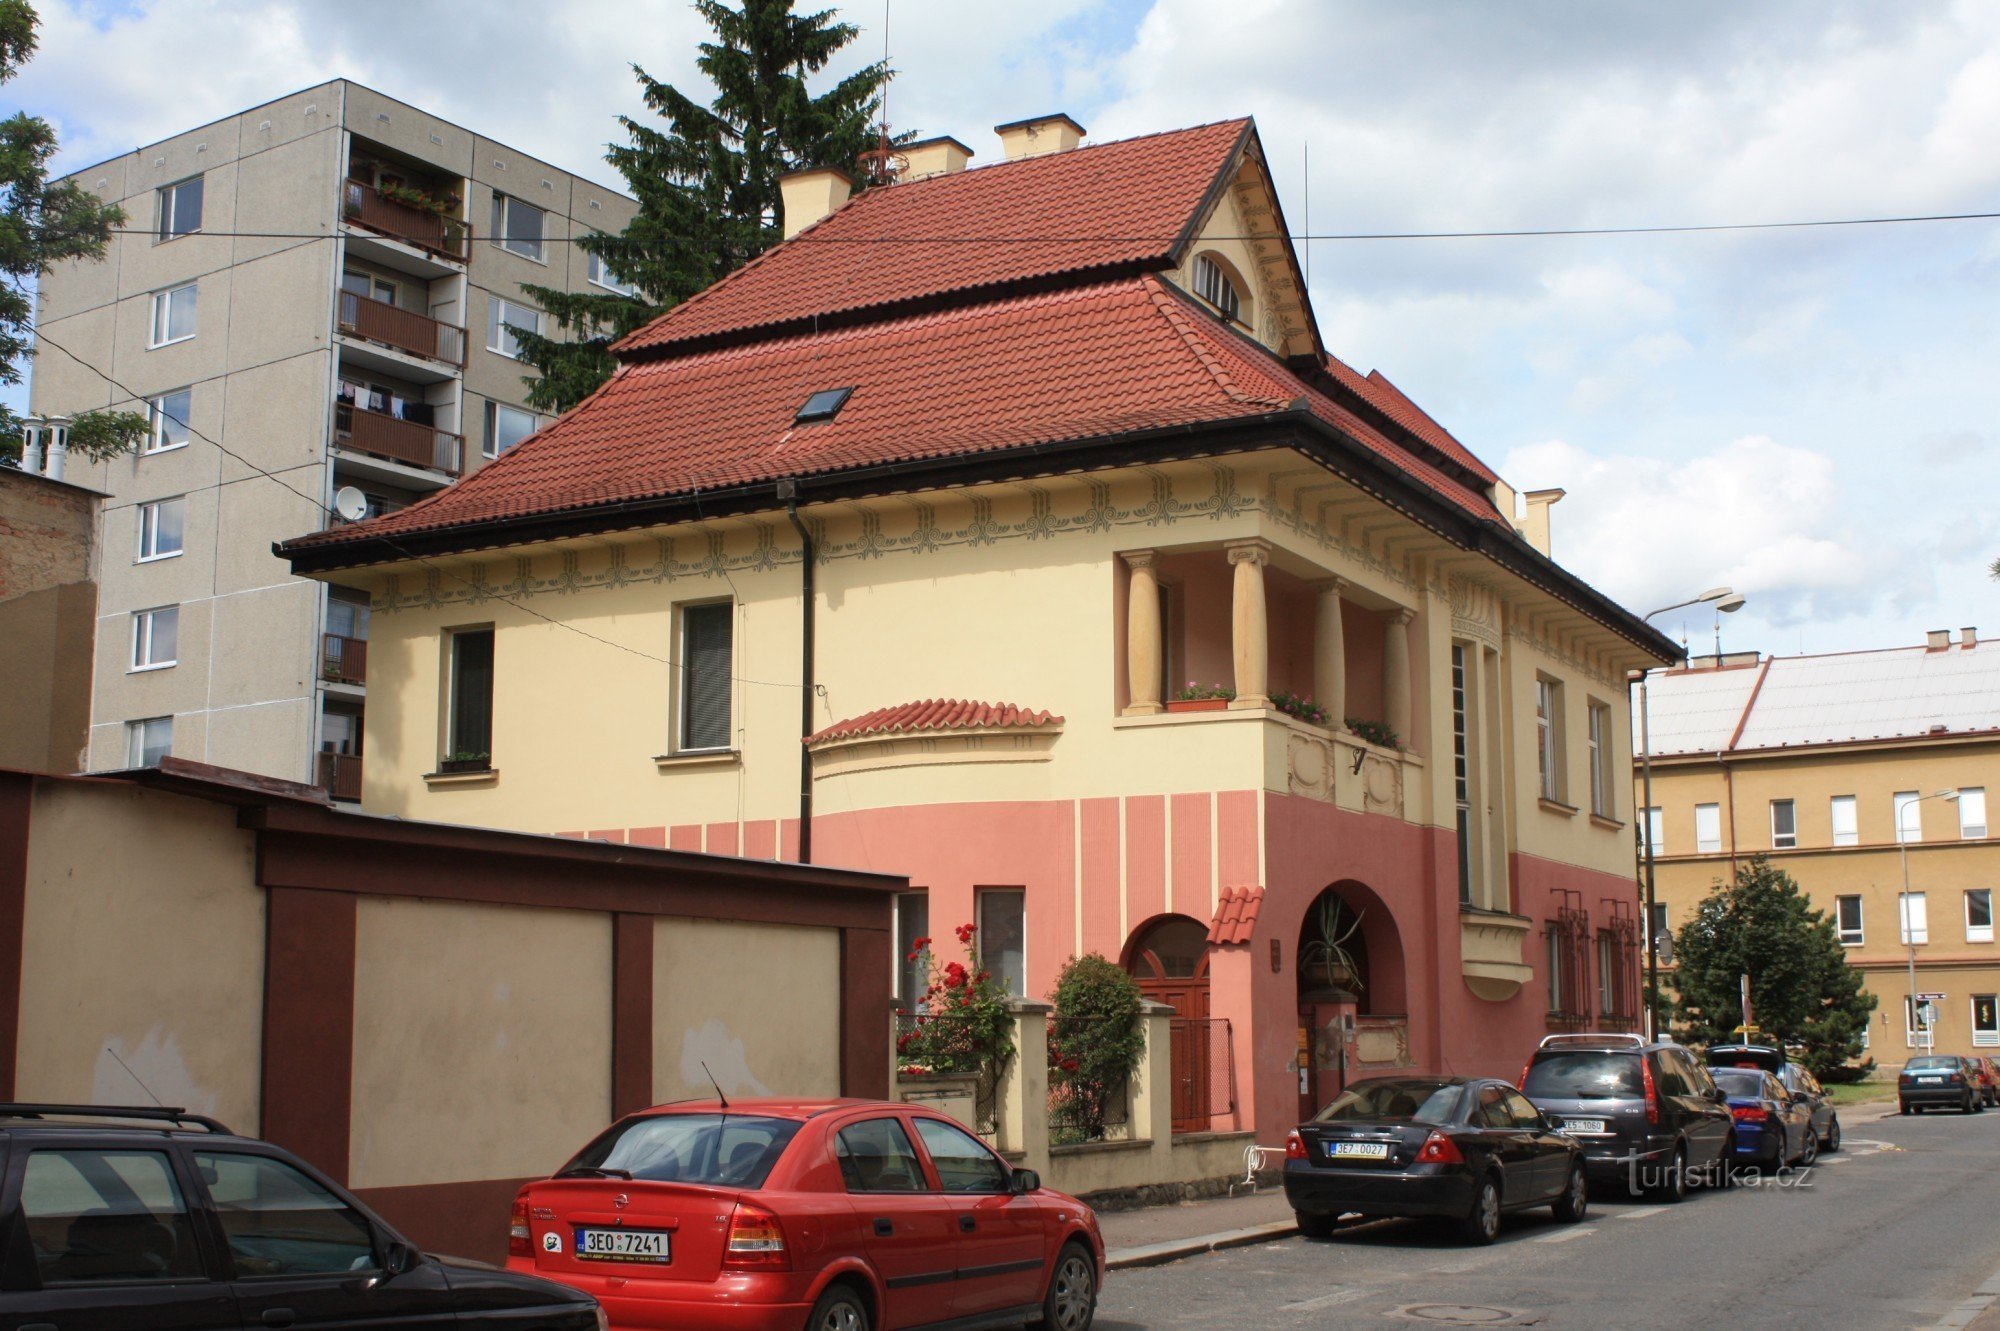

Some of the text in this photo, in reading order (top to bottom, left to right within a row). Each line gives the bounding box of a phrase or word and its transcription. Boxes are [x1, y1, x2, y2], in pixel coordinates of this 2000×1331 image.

[1337, 1144, 1354, 1154] 3E7
[1360, 1144, 1383, 1155] 0027
[588, 1233, 660, 1253] 3E0 7241
